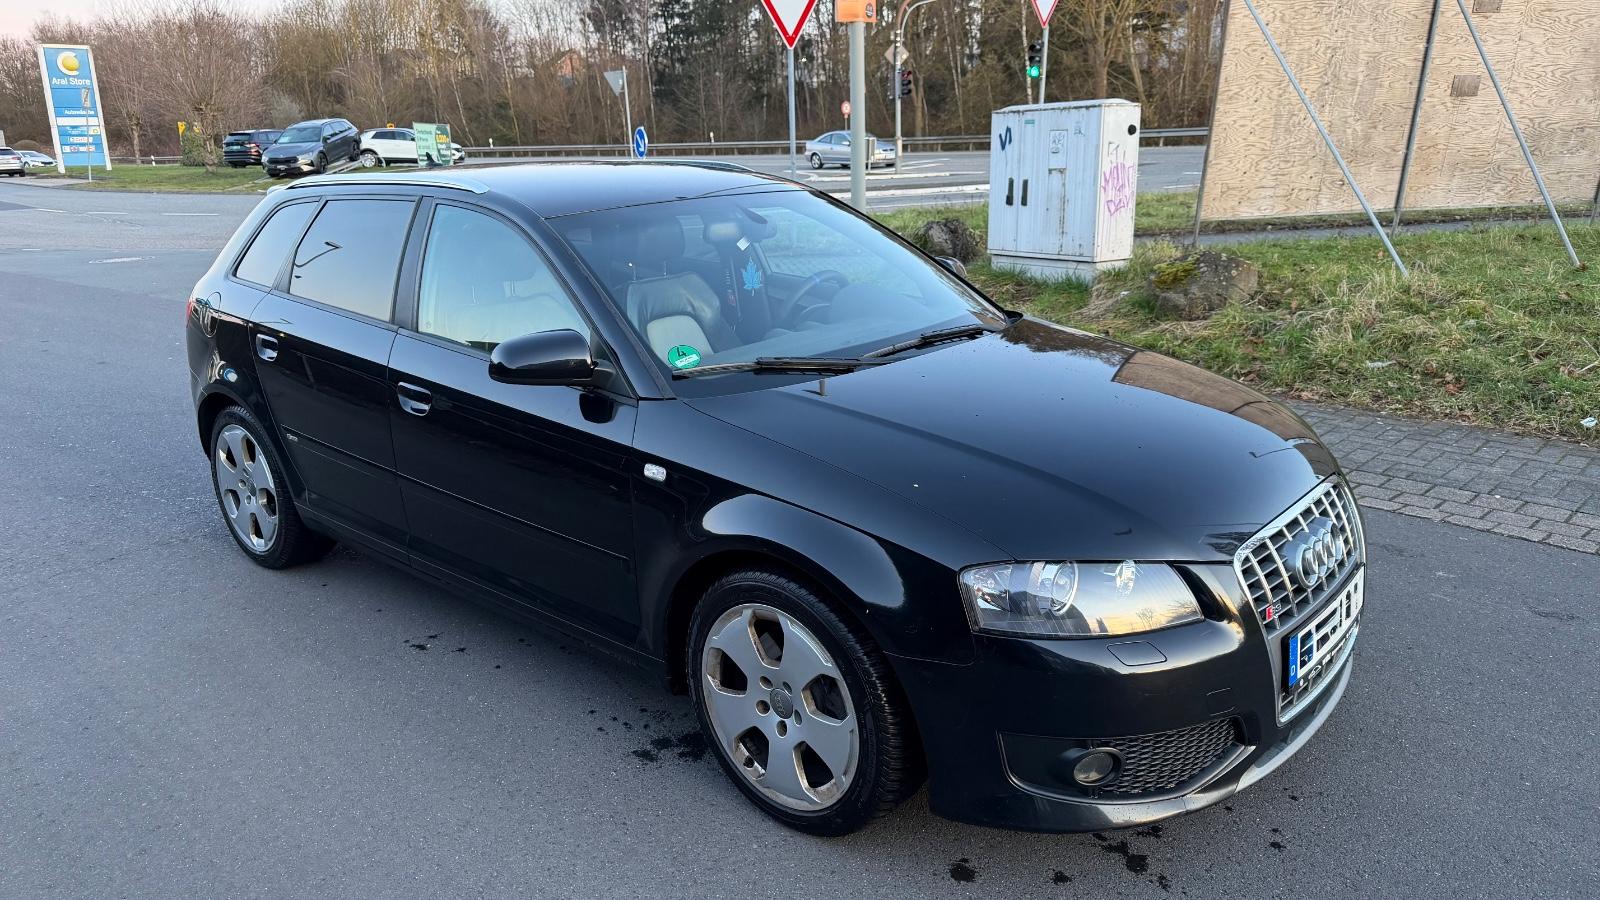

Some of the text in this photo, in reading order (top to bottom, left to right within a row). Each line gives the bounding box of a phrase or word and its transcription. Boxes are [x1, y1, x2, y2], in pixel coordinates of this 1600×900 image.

[52, 77, 91, 86] Aral Store
[677, 347, 687, 357] 4
